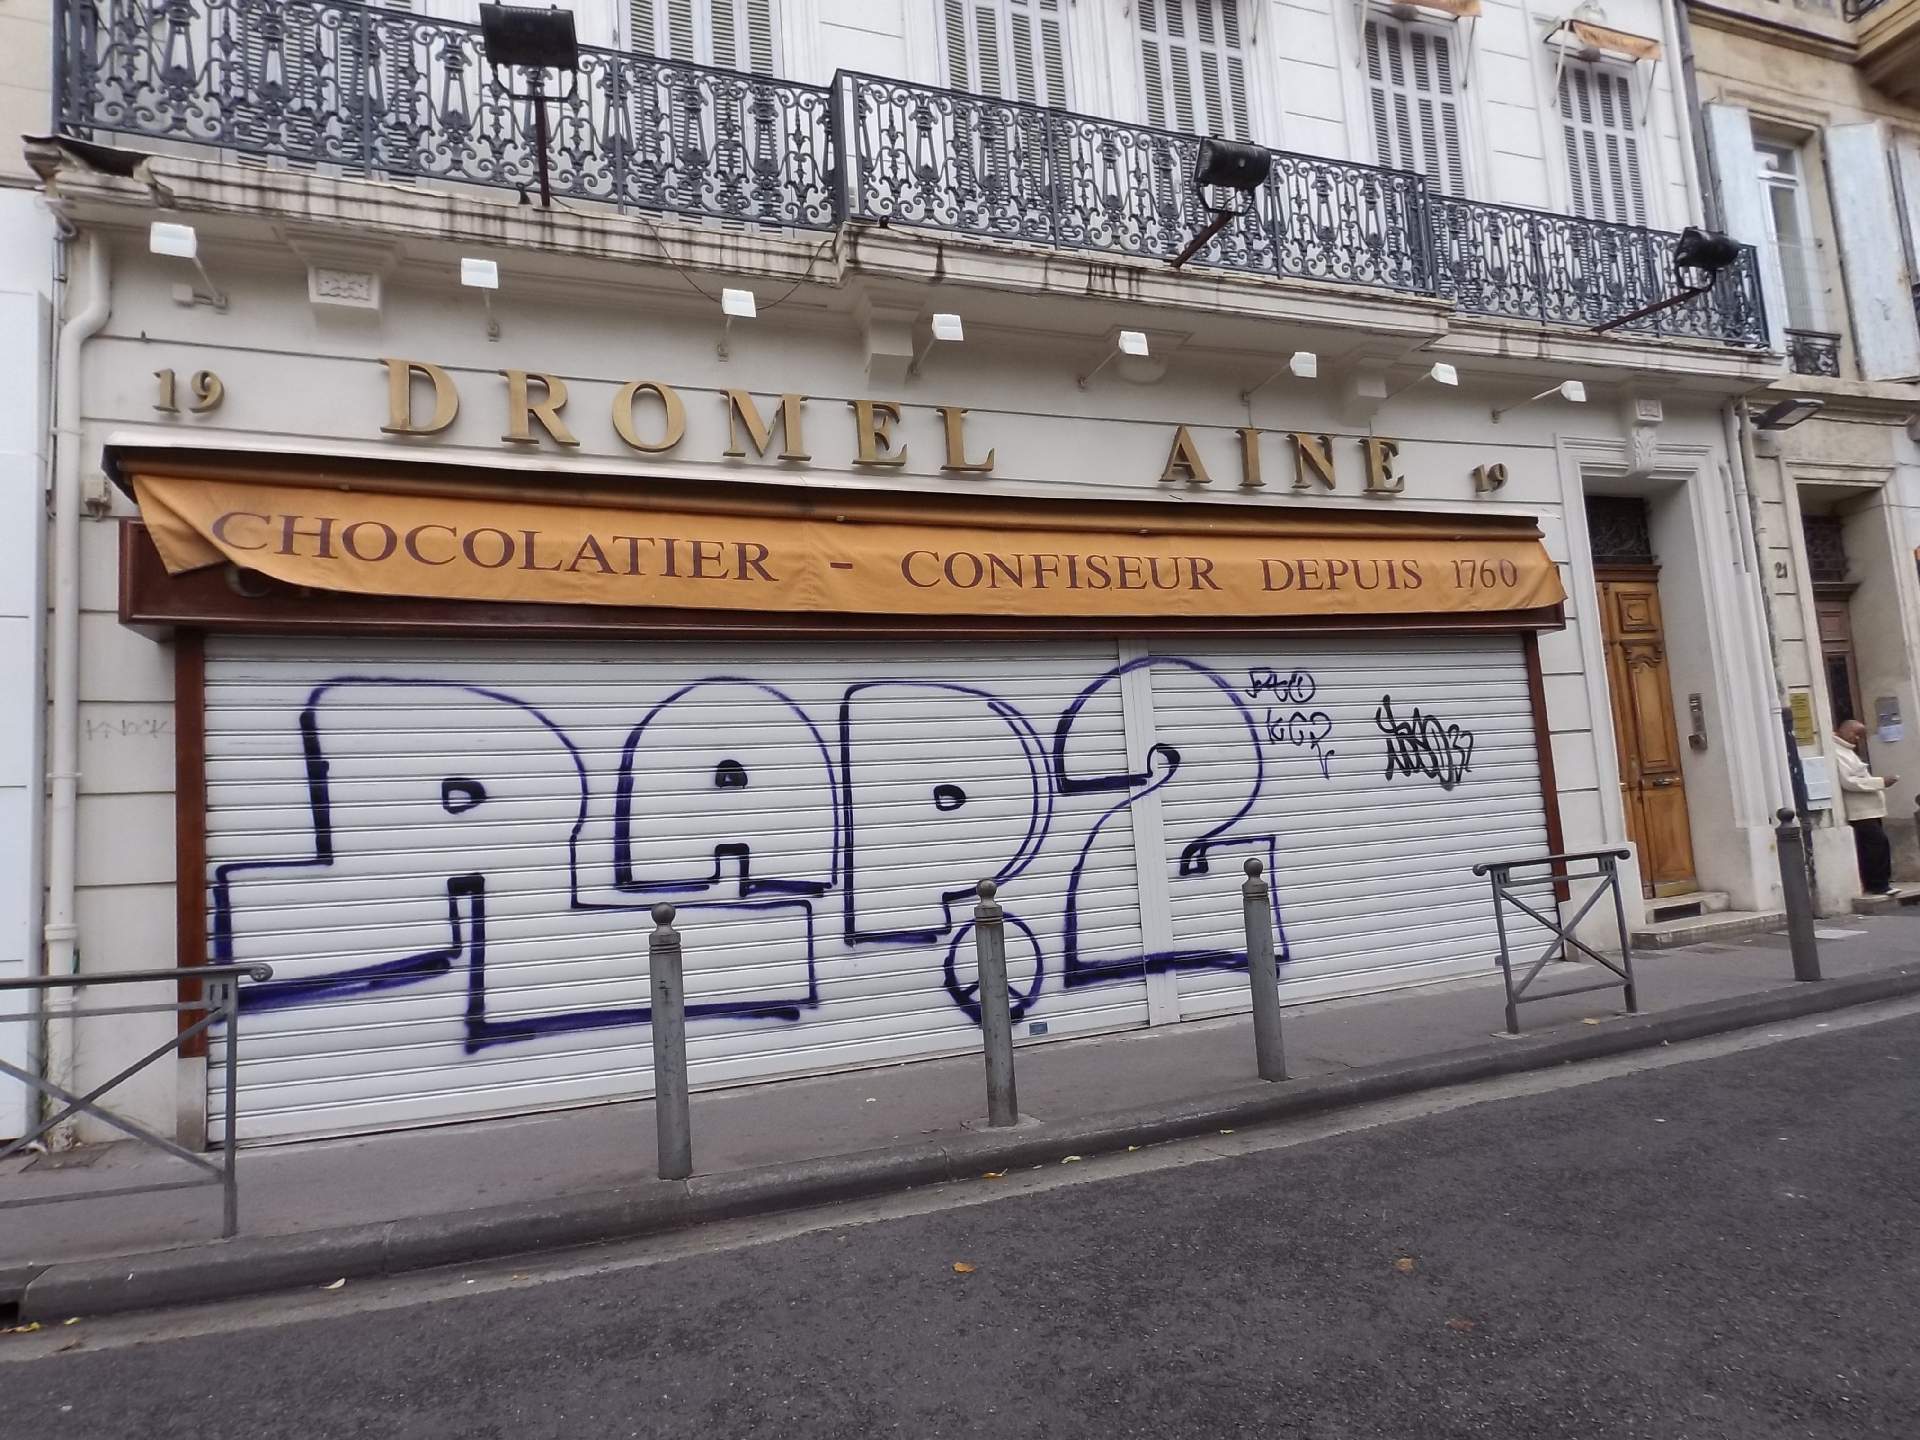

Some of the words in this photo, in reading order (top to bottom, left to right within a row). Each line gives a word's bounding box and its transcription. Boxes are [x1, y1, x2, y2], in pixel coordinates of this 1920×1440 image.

[151, 368, 225, 415] 19
[379, 358, 996, 473] DROMEL
[1158, 424, 1405, 495] AINE
[1470, 462, 1509, 495] 19
[211, 510, 780, 583] CHOCOLATIER
[900, 549, 1224, 592] CONFISEUR
[1261, 557, 1424, 592] DEPUIS
[1450, 558, 1519, 590] 1760
